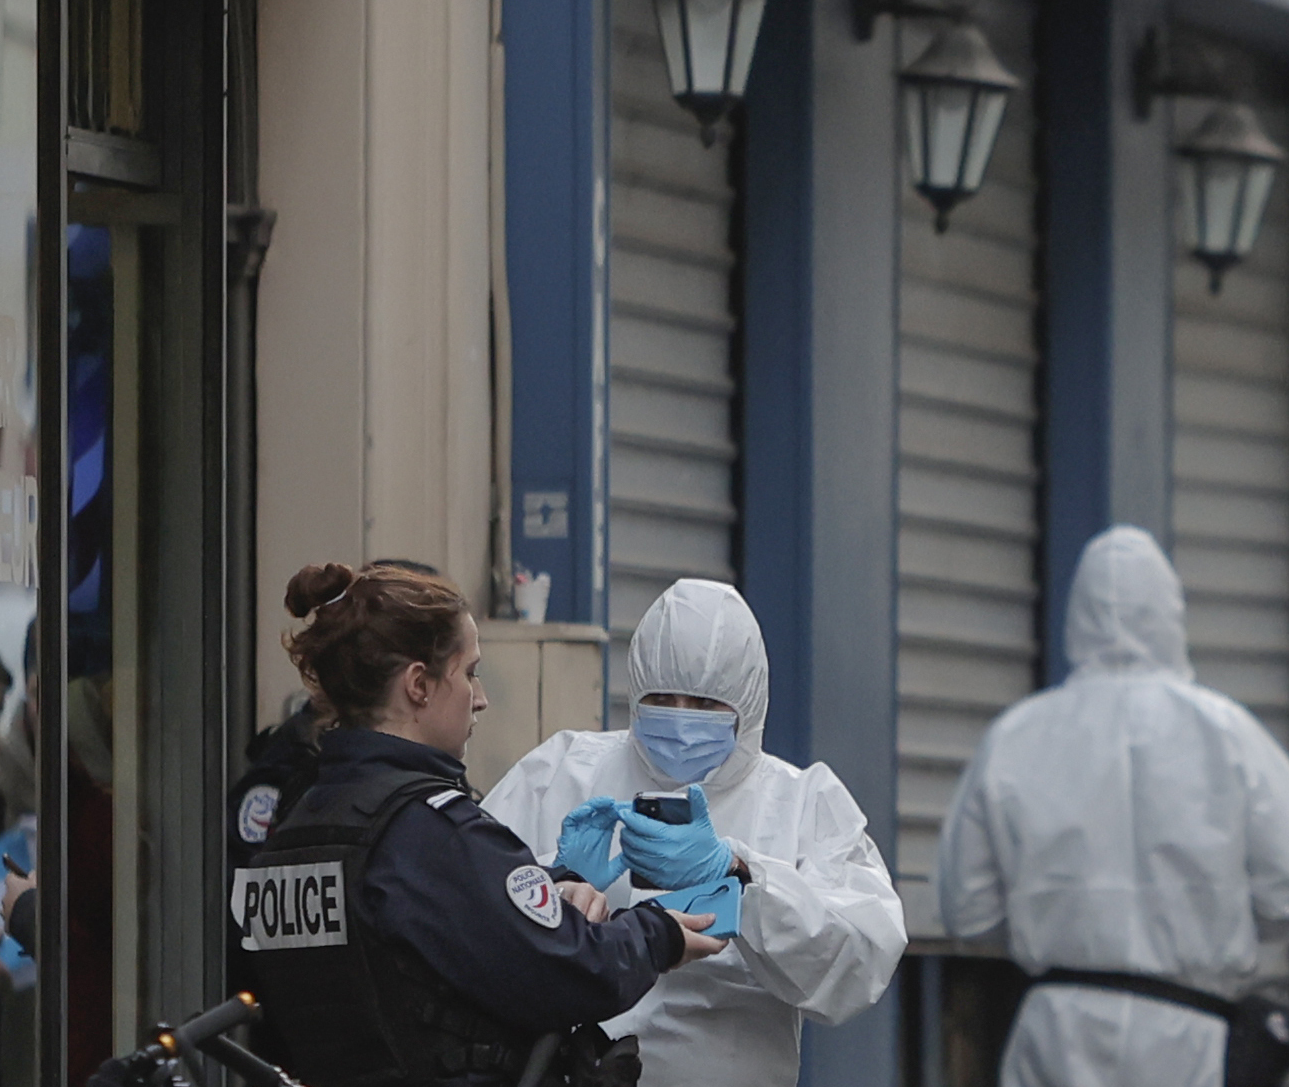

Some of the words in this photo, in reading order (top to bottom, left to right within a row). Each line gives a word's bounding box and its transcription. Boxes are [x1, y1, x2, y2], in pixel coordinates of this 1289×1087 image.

[511, 874, 546, 894] NATIONALE
[513, 869, 535, 884] POLICE
[244, 875, 341, 938] POLICE
